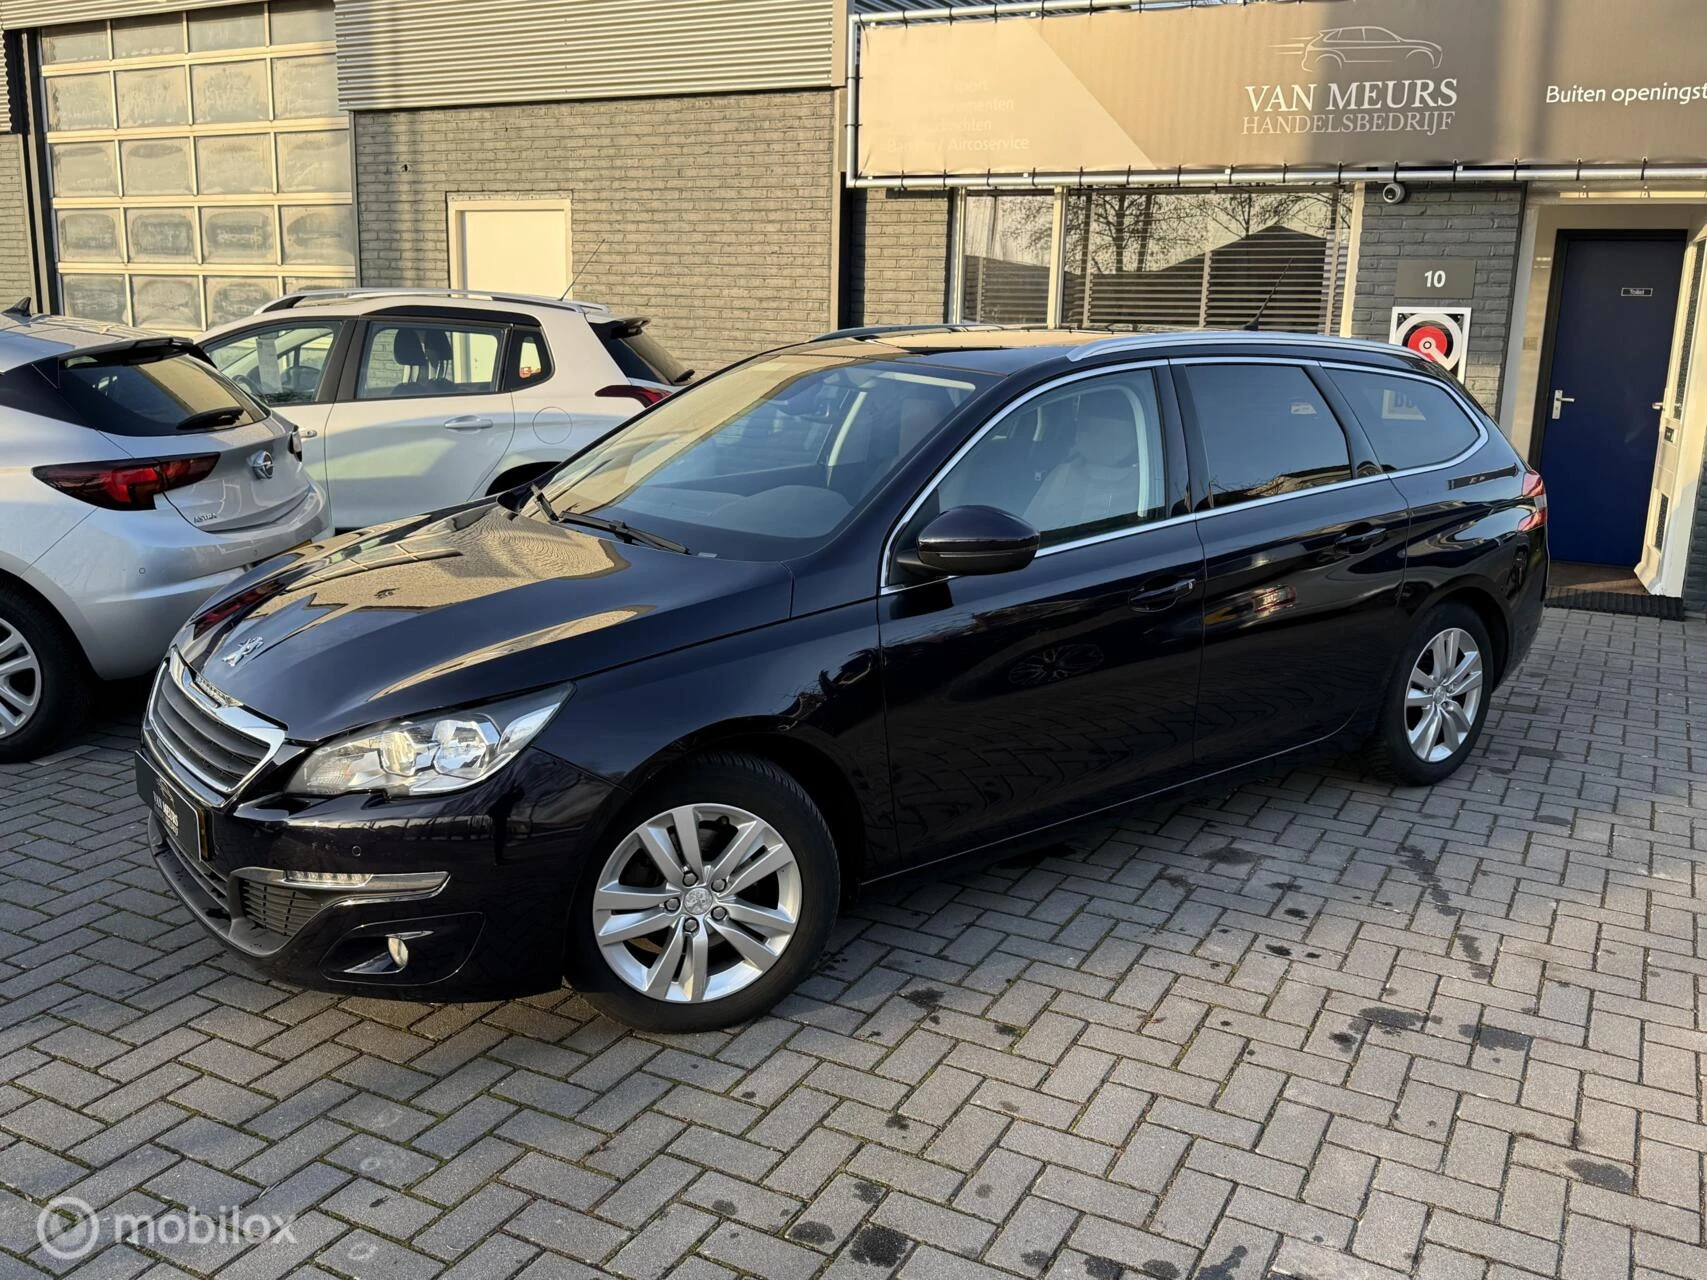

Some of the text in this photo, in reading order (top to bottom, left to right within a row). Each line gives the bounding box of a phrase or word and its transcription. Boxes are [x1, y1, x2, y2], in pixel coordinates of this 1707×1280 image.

[1244, 78, 1458, 113] VAN MEURS
[1546, 85, 1606, 103] Buiten
[1241, 111, 1456, 136] HANDELSBEDRIJF
[948, 133, 1030, 151] Aircoservice
[1424, 270, 1446, 288] 10
